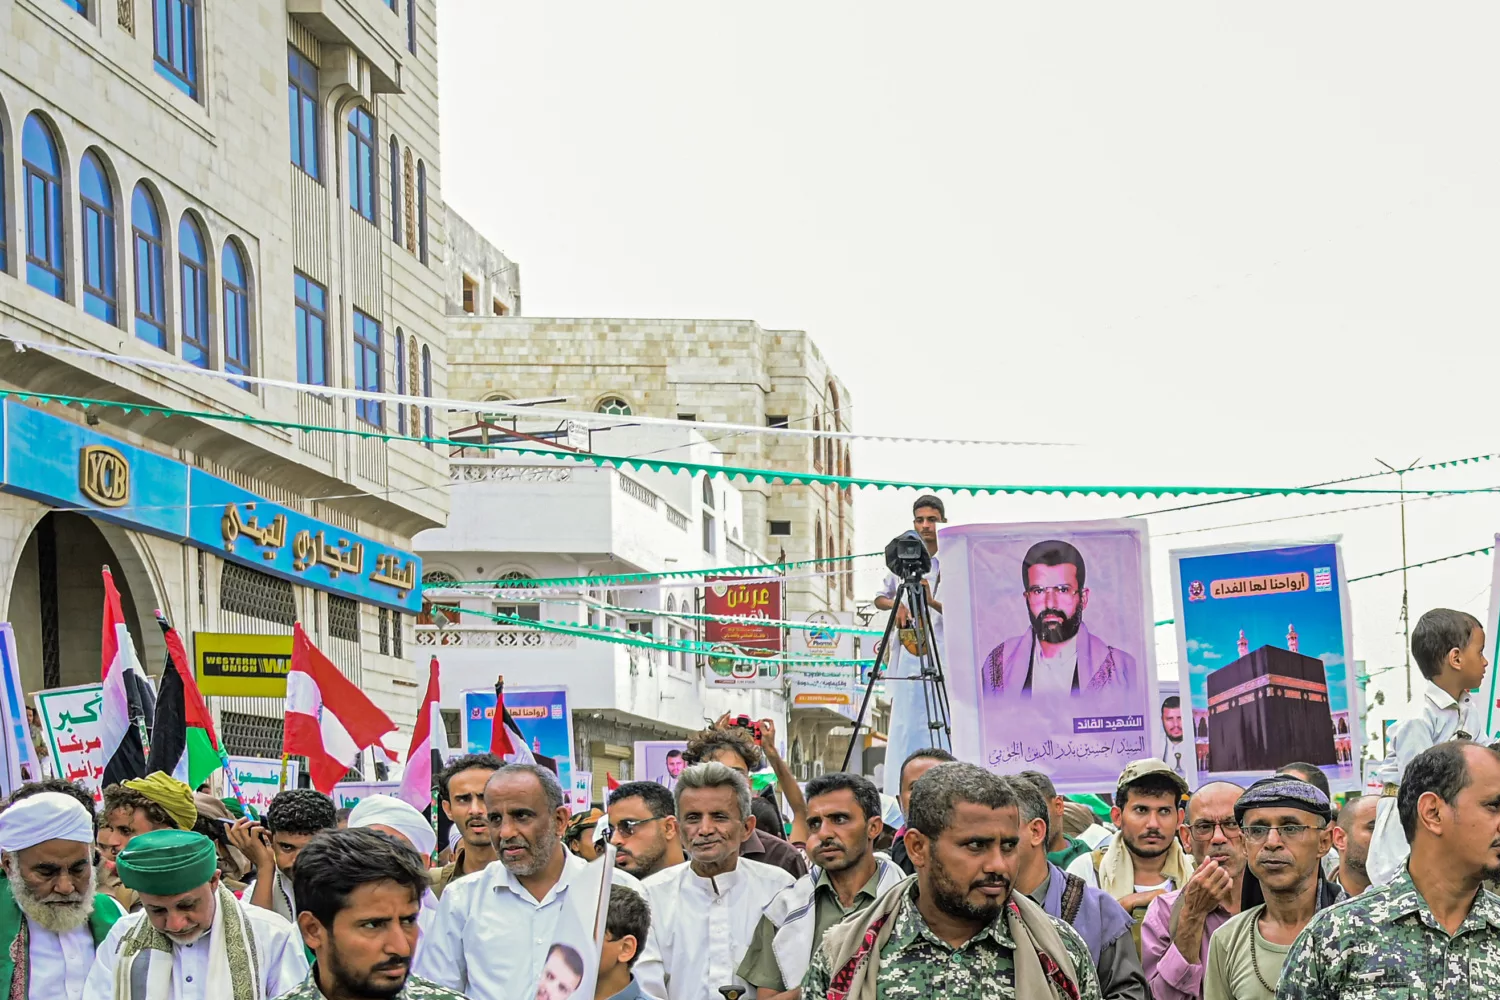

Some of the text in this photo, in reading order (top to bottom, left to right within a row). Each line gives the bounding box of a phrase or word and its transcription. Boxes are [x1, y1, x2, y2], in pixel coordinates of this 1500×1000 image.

[89, 450, 127, 501] YCB
[221, 501, 416, 599] البنك التجاري اليمني
[1214, 581, 1247, 596] الفداء
[1249, 578, 1267, 592] لها
[1269, 573, 1306, 591] أرواحنا
[206, 656, 257, 665] WESTERN
[222, 664, 257, 673] UNION
[1077, 716, 1142, 731] الشهيد القائد
[57, 734, 102, 754] مريكا
